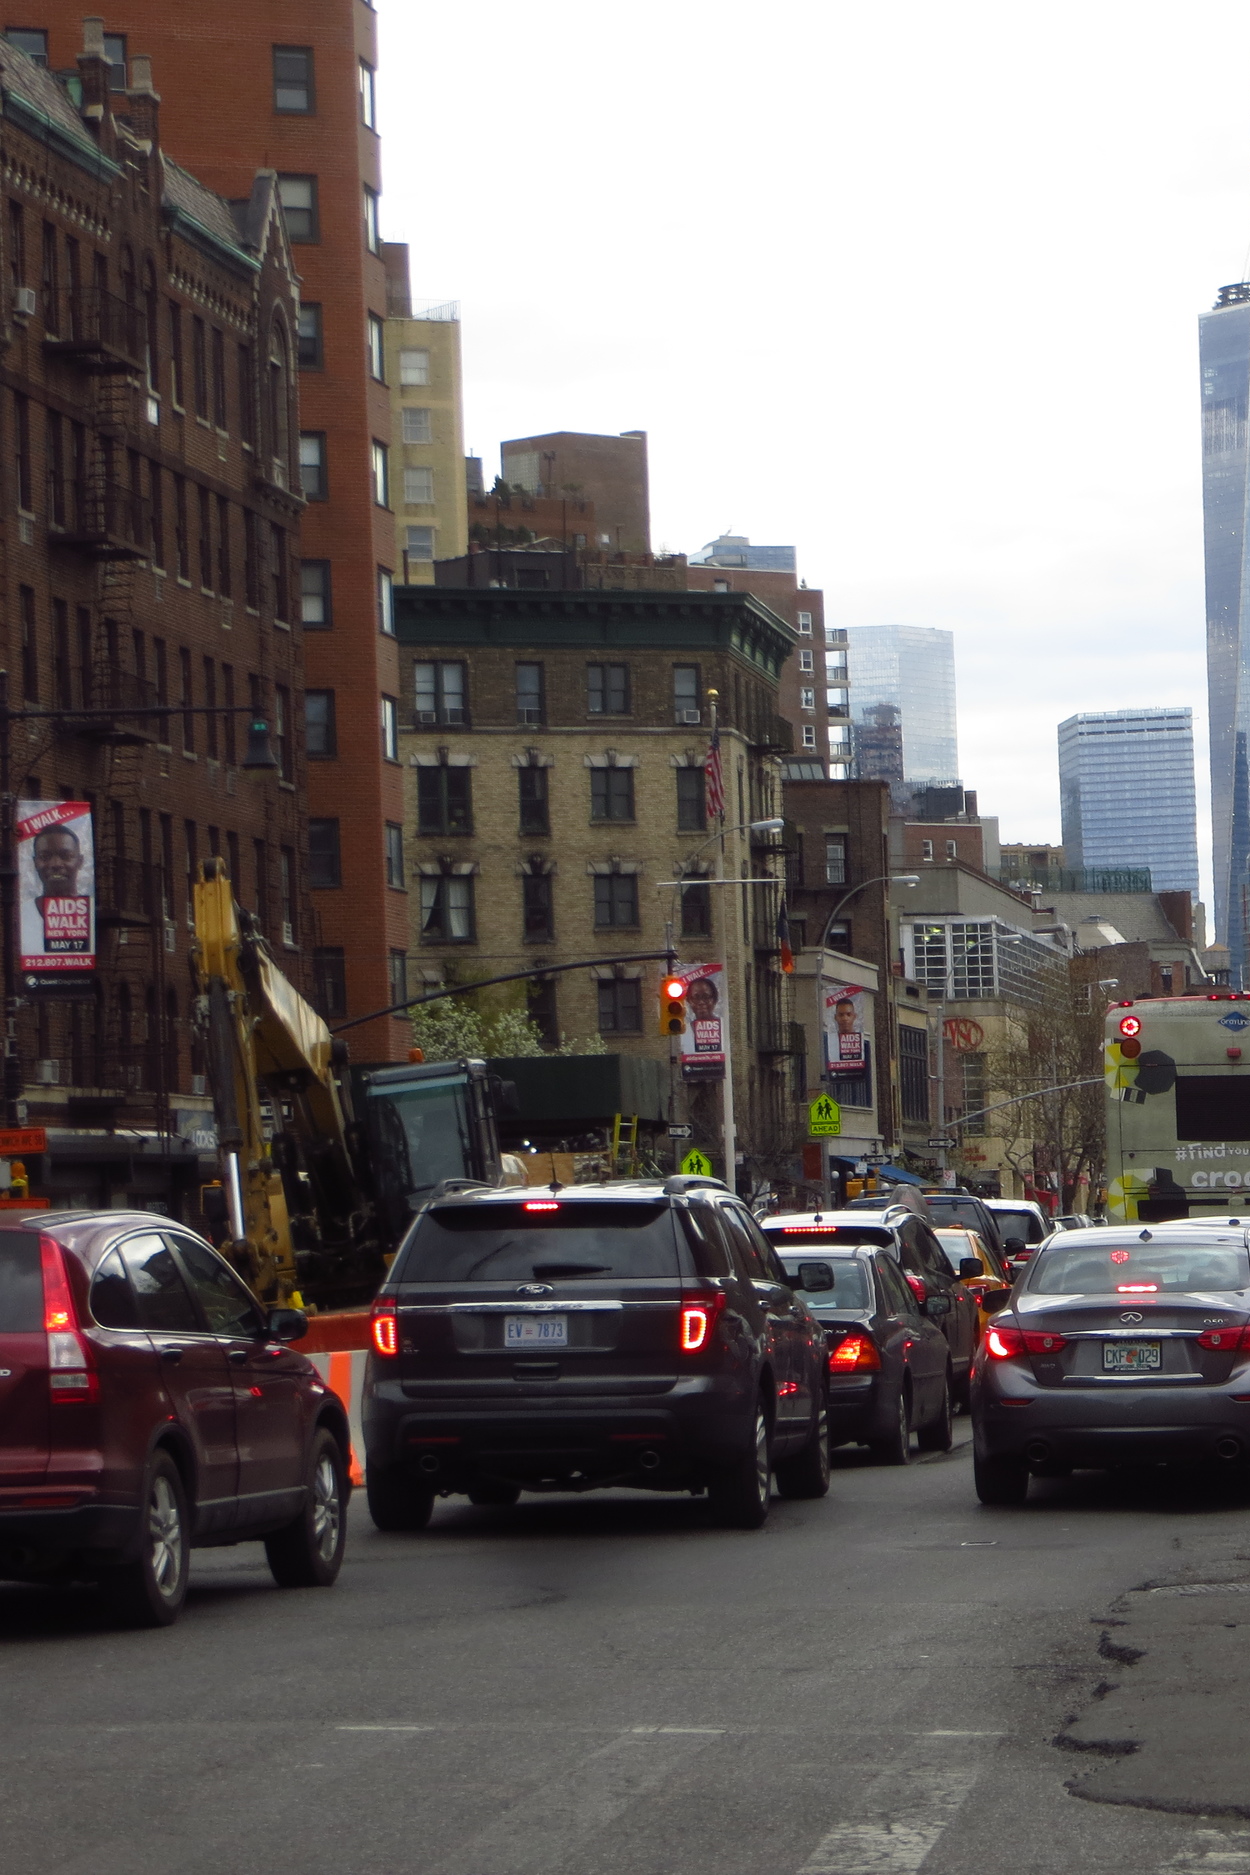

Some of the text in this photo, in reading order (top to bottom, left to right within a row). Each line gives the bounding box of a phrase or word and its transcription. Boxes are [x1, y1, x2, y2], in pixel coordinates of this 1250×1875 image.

[23, 822, 31, 834] I
[47, 899, 87, 914] AIDS
[47, 915, 87, 928] WALK
[47, 929, 87, 937] NEW YORK
[51, 940, 84, 949] MAY 17
[696, 1021, 719, 1030] AIDS
[841, 1034, 860, 1042] AIDS
[508, 1322, 563, 1338] EV 7873
